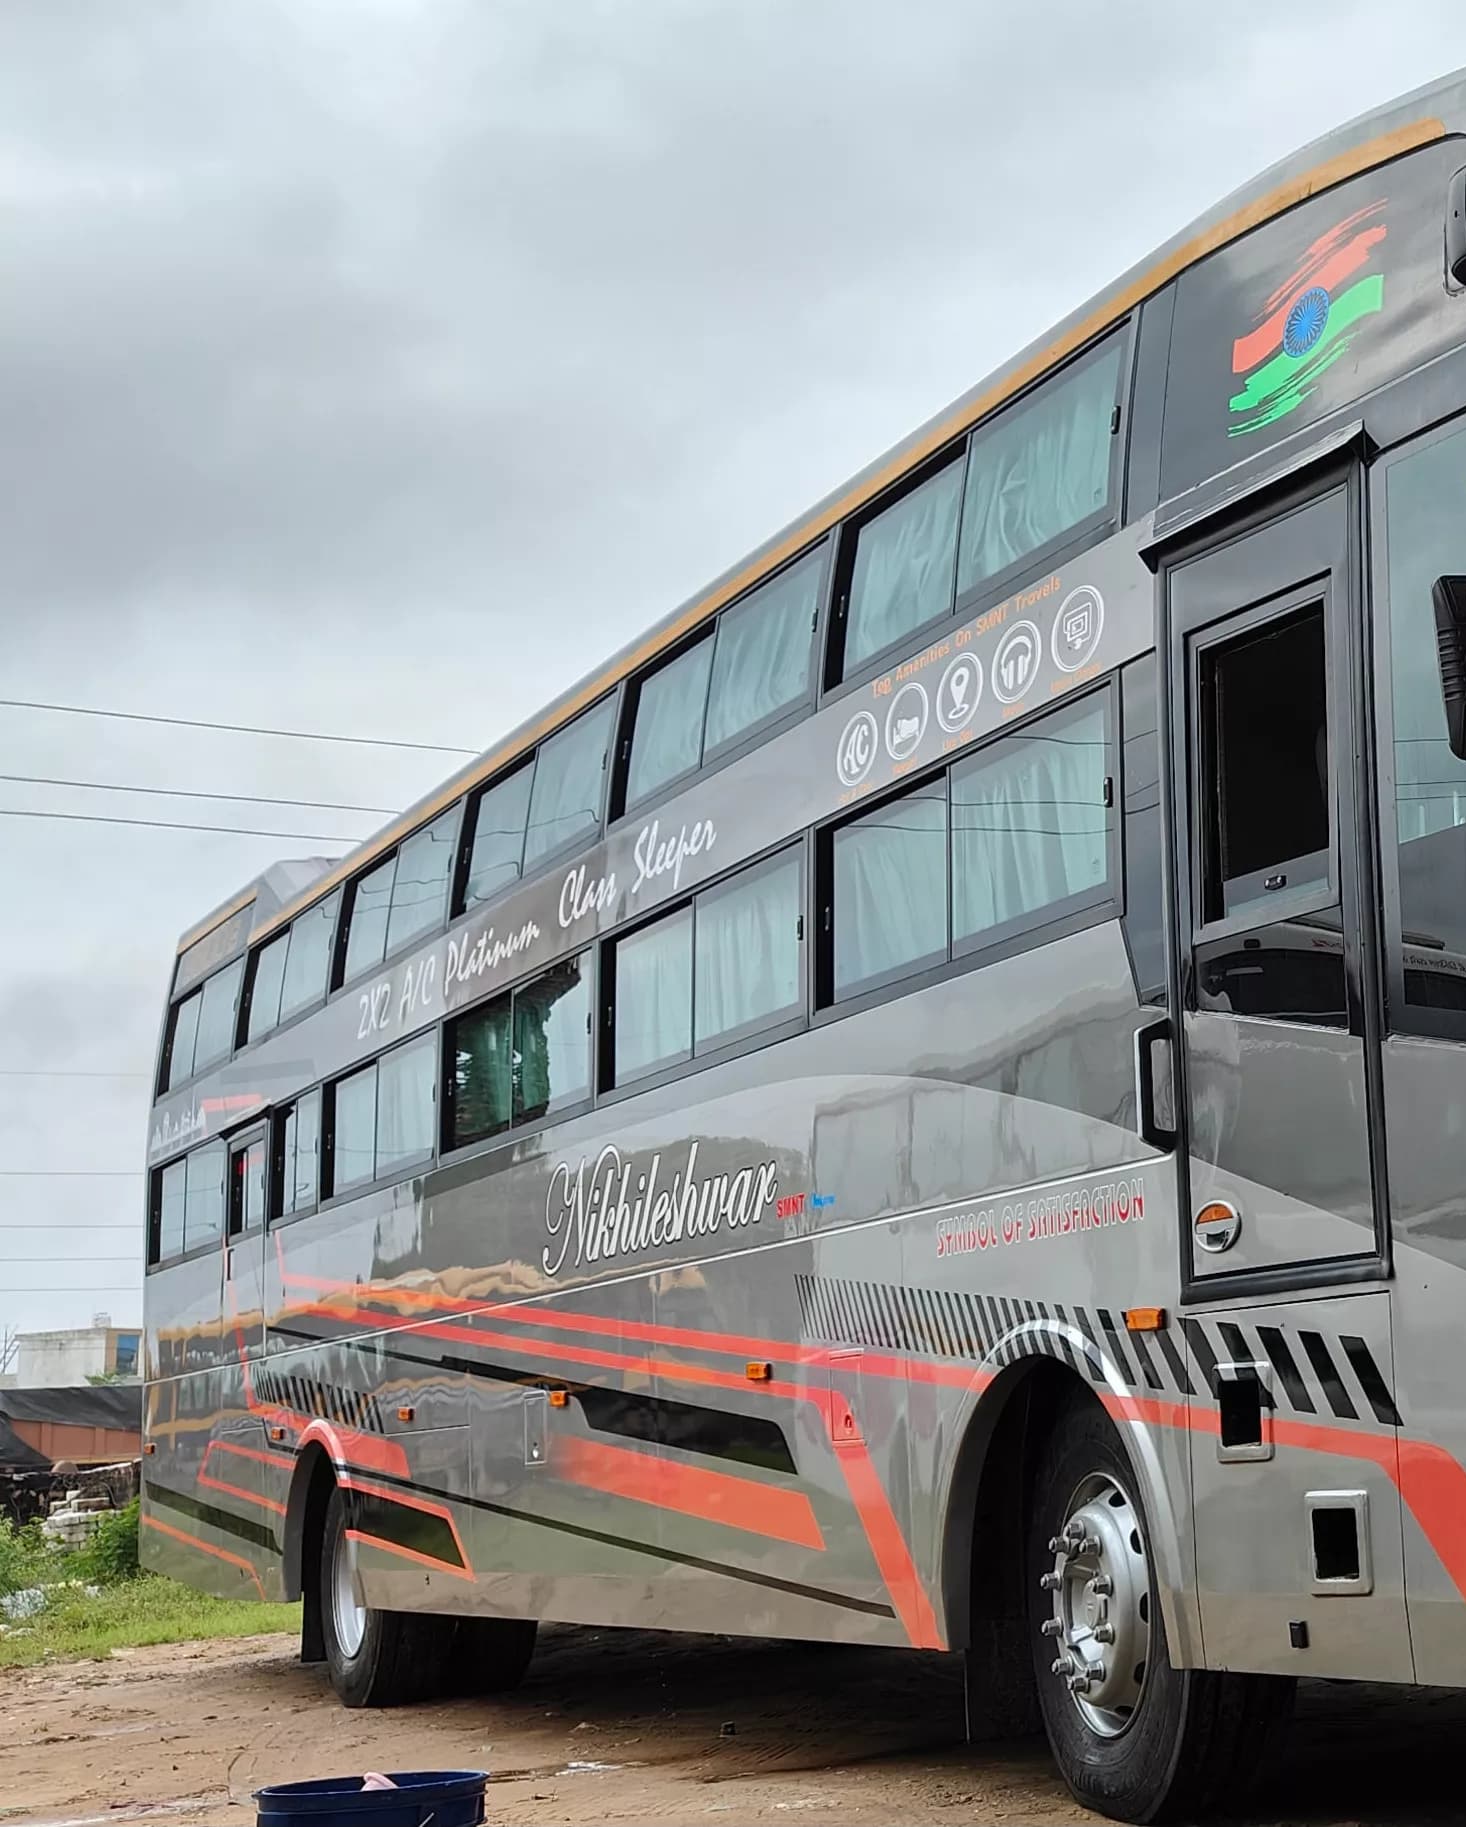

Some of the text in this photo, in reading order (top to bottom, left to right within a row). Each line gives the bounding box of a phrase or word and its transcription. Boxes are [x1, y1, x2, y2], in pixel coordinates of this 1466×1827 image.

[872, 676, 892, 699] Top
[896, 642, 950, 682] Amenities
[955, 629, 972, 649] On
[1015, 576, 1061, 612] Travels
[843, 723, 869, 775] AC
[357, 820, 717, 1040] 2X2 A/C Platinum Class Sleeper
[542, 1139, 778, 1276] Nikhileshwar
[936, 1178, 1144, 1258] SYMBOL OF SATISFACTION
